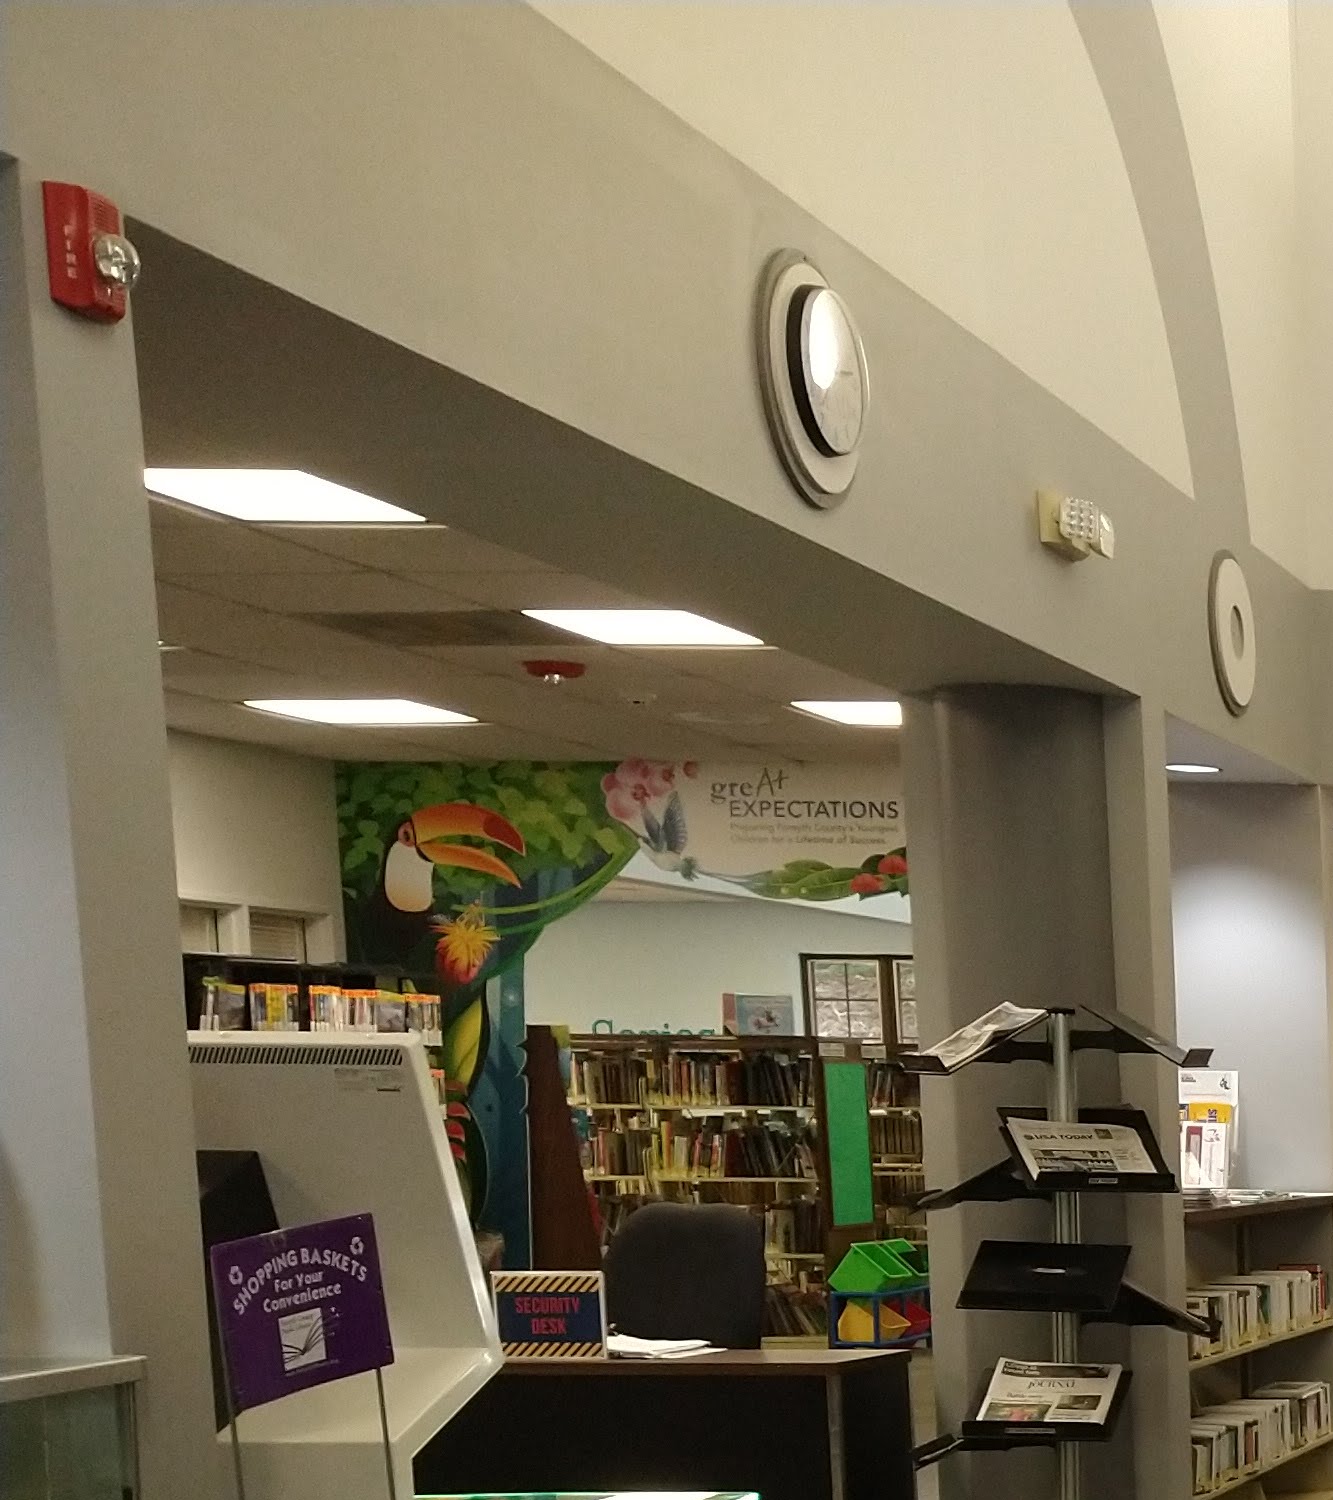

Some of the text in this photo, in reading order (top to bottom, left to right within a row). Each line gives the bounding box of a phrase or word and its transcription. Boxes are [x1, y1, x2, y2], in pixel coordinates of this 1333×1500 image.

[729, 800, 899, 819] EXPECTATIONS
[233, 1248, 367, 1316] SHOPPING BASKETS
[274, 1271, 323, 1293] For Your
[263, 1283, 342, 1313] Convenience
[514, 1296, 580, 1314] SECURITY
[531, 1318, 567, 1335] DESK
